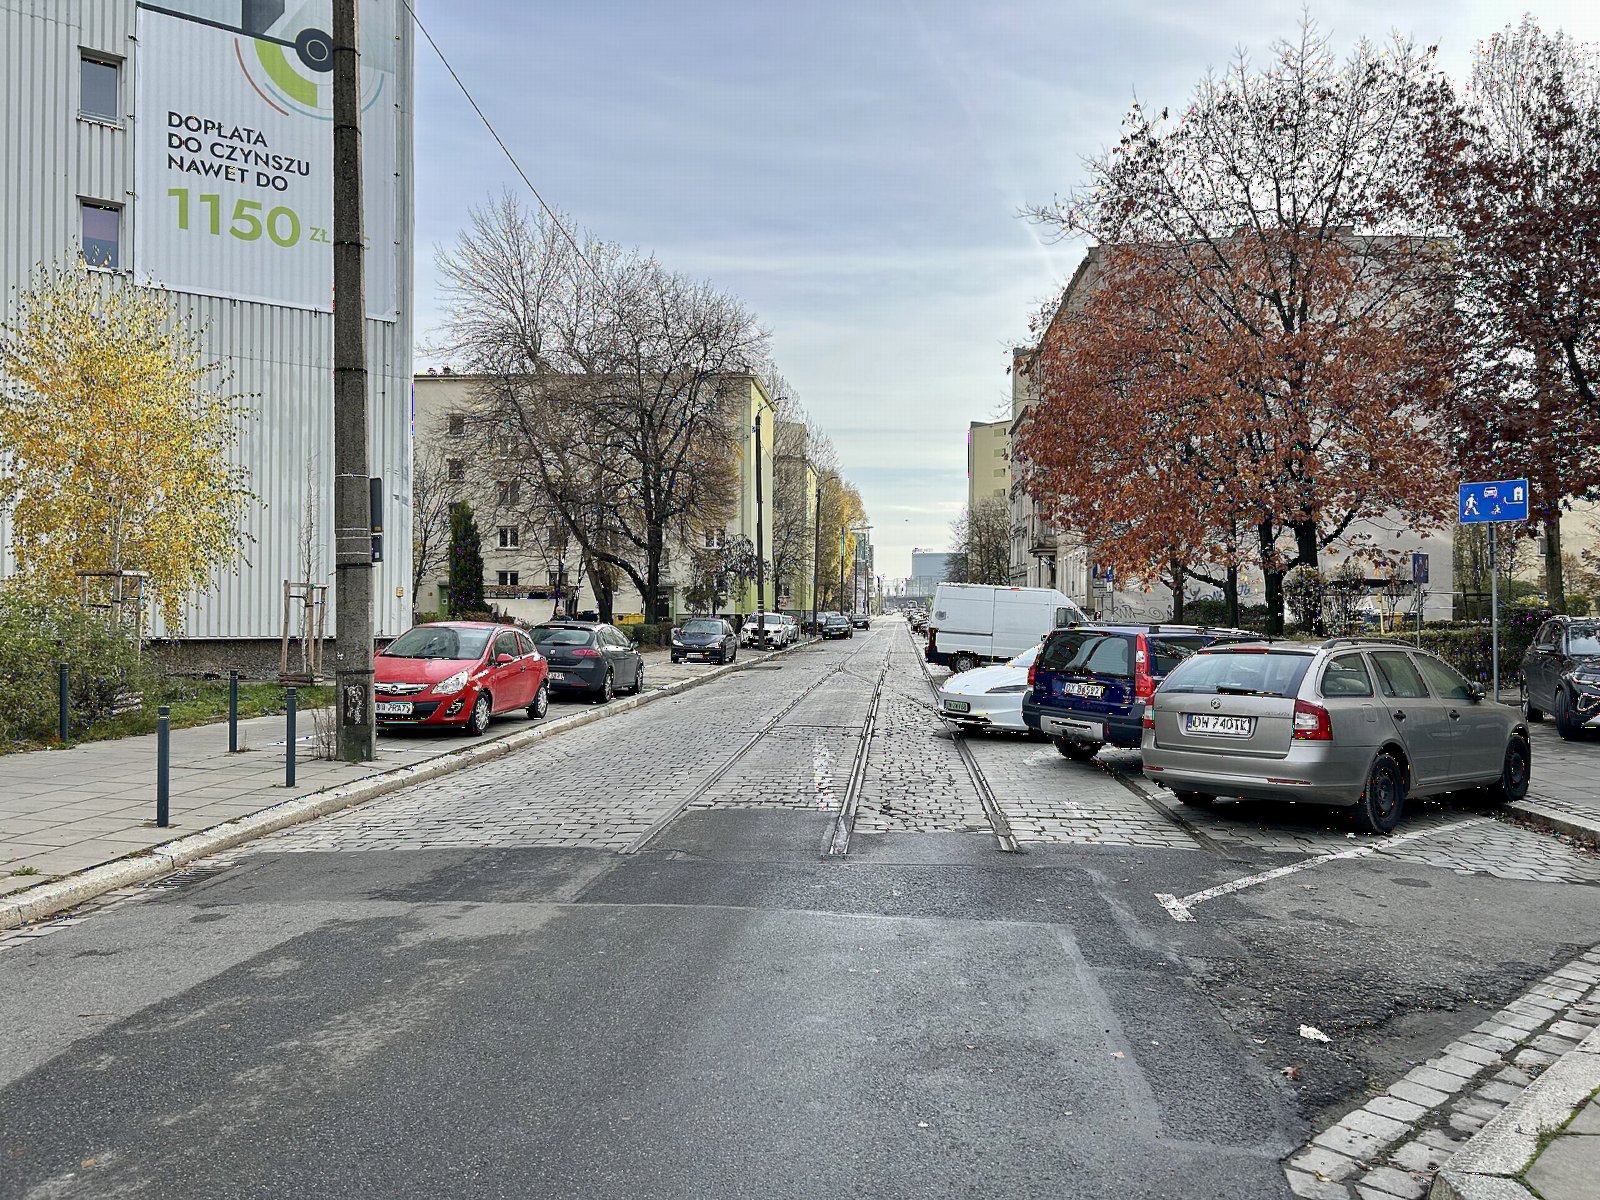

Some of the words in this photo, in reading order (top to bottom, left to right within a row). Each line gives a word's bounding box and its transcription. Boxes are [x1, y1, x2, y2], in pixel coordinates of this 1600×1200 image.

[168, 111, 268, 147] DOPŁATA
[168, 132, 202, 153] DO
[210, 142, 310, 176] CZYNSZU
[168, 153, 249, 183] NAWET
[256, 171, 288, 191] DO
[168, 188, 301, 248] 1150
